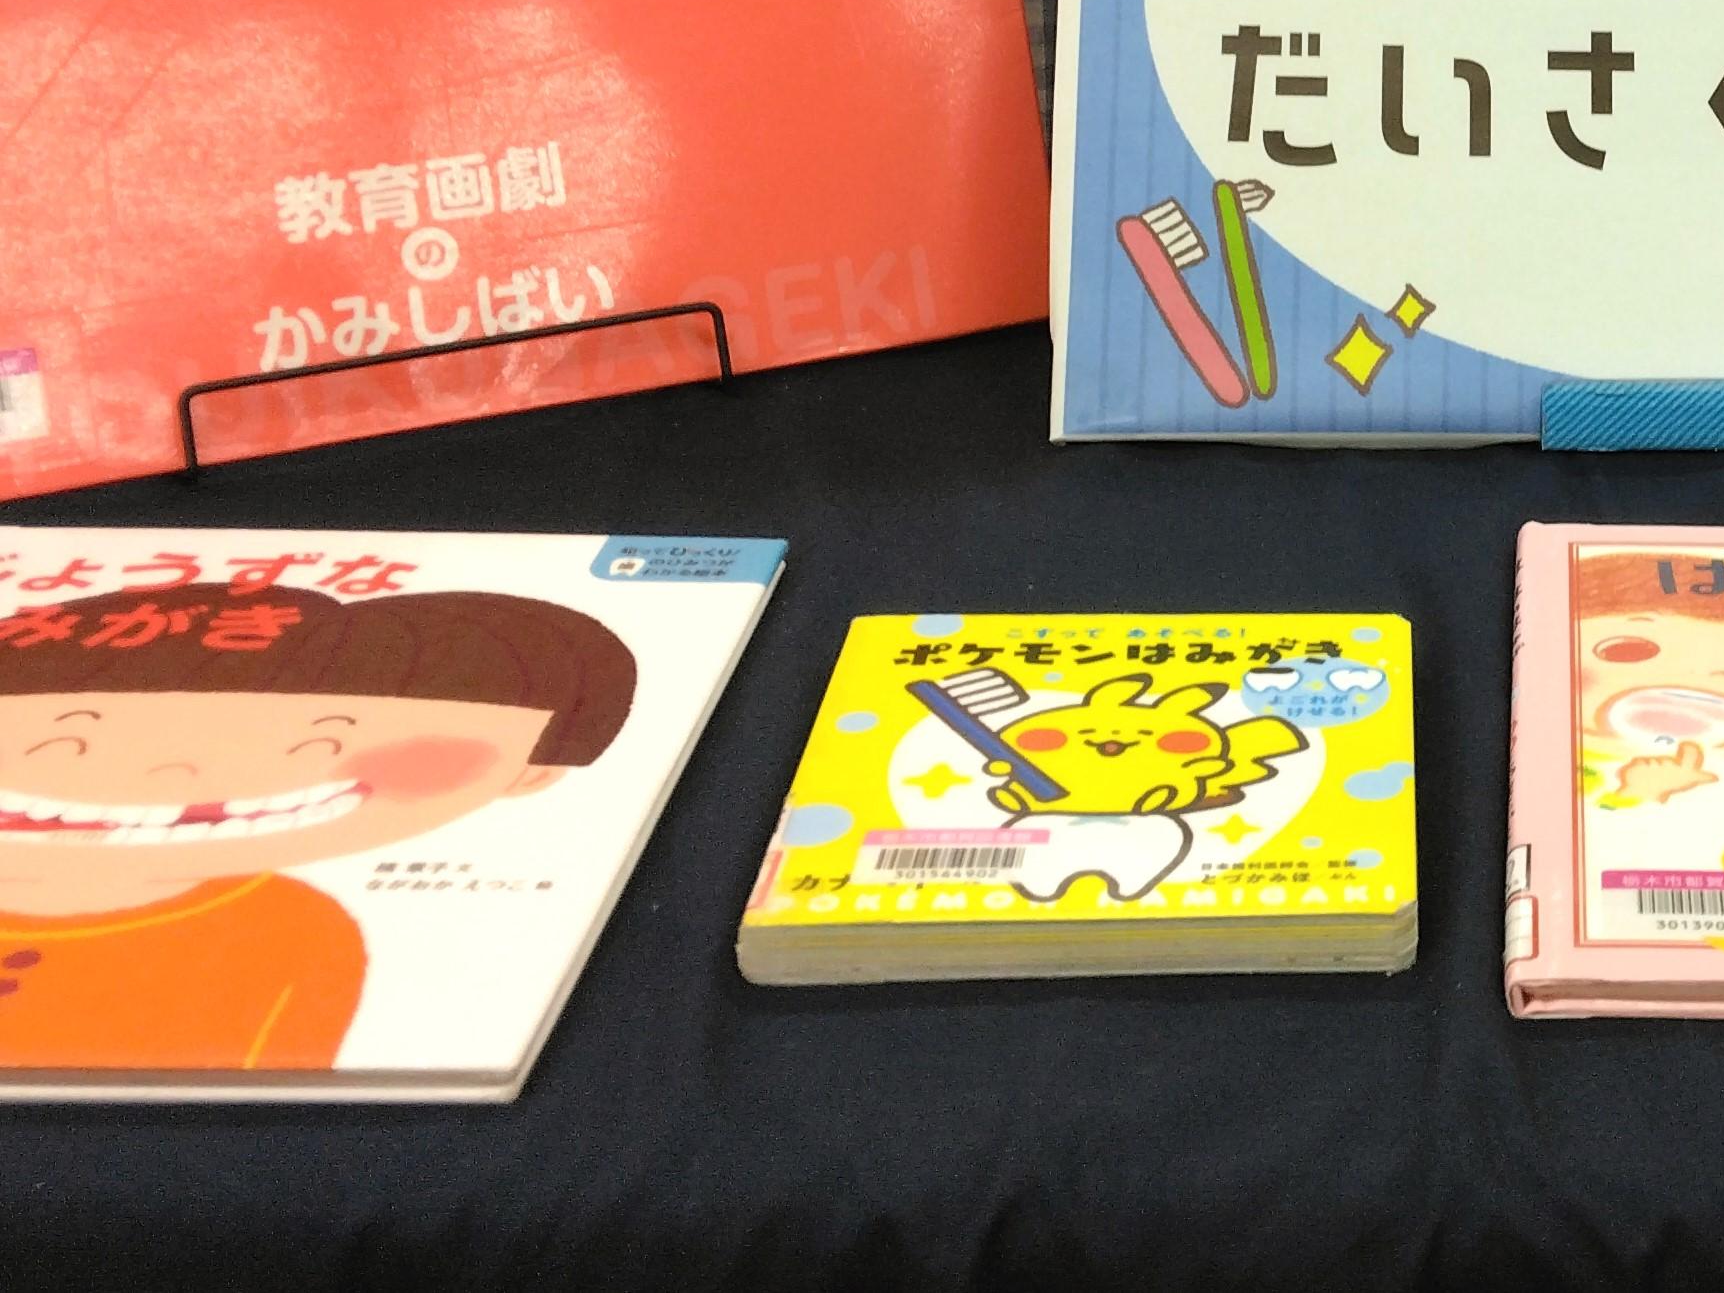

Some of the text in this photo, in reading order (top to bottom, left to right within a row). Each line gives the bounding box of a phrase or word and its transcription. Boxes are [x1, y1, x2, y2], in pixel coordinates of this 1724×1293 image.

[273, 141, 567, 246] 教育画劇
[407, 233, 455, 275] の
[252, 266, 617, 374] かみしばい
[0, 604, 303, 649] みがき
[1005, 625, 1106, 640] こすって
[893, 636, 1344, 667] ポケモンはみがき
